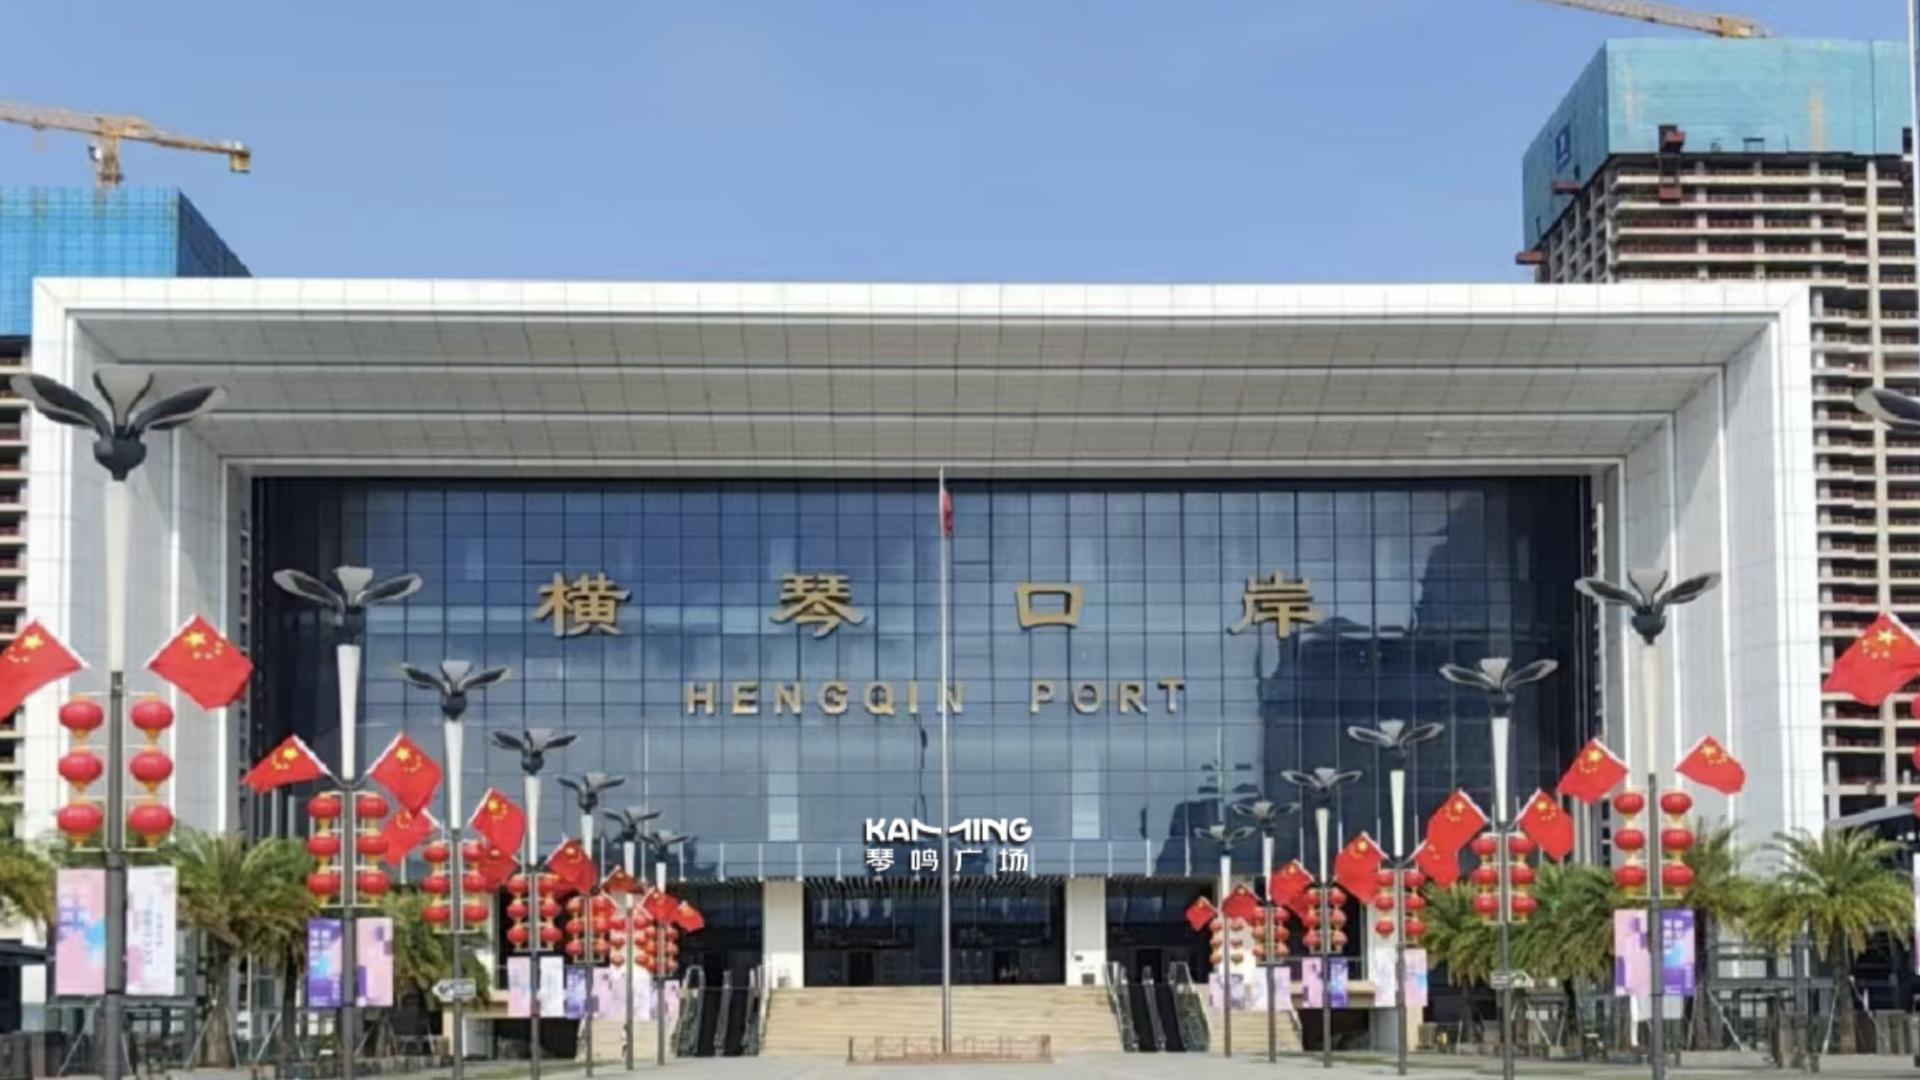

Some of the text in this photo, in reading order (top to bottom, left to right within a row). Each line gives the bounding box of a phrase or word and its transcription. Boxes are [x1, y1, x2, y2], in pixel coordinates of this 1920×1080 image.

[533, 572, 1320, 637] 横琴口岸
[686, 681, 1185, 714] HENGQIN PORT
[865, 848, 1029, 872] 琴鸣广场
